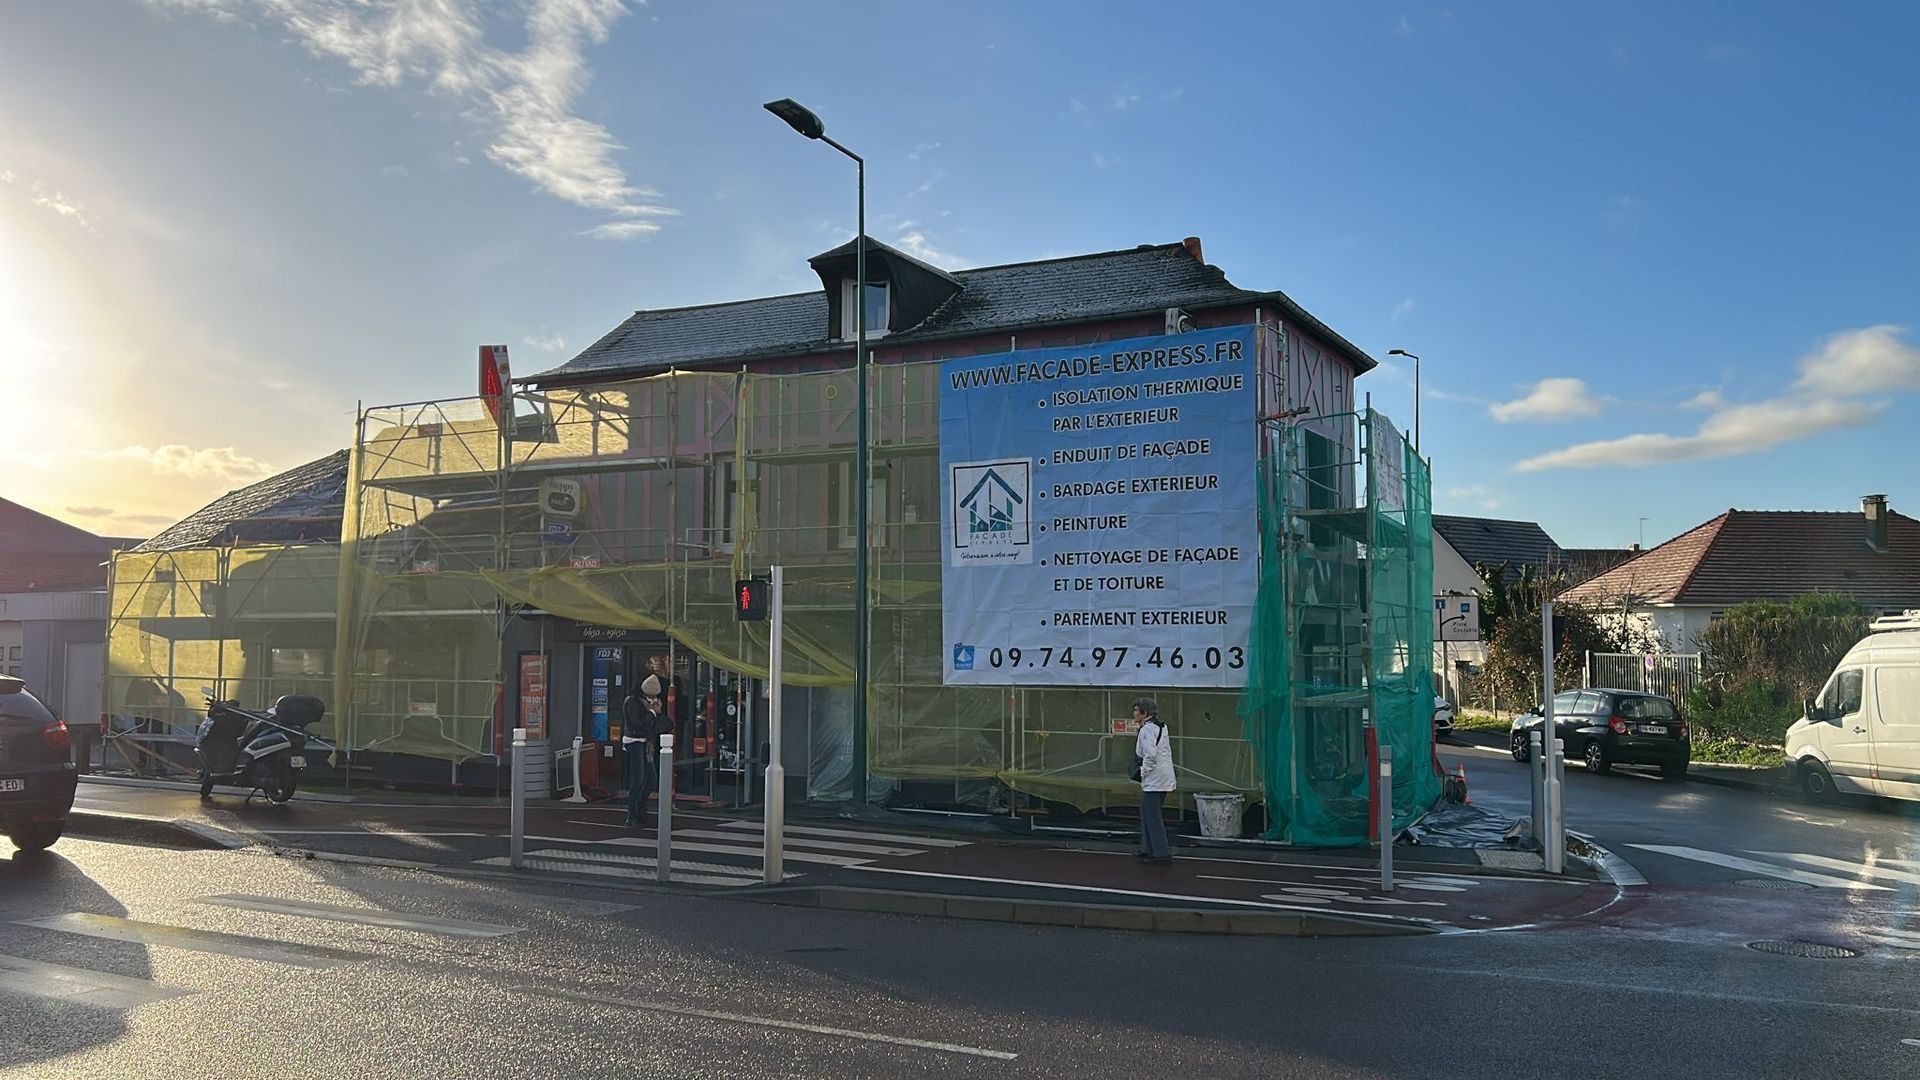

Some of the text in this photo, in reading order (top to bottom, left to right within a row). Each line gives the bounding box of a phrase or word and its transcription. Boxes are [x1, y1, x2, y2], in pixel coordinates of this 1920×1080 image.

[950, 340, 1243, 390] WWW.FACADE-EXPRESS.FR
[1052, 375, 1243, 407] ISOLATION THERMIQUE
[1052, 407, 1180, 432] PAR L'EXTERIEUR
[1052, 439, 1210, 465] ENDUIT DE FAÇADE
[1053, 475, 1219, 498] BARDAGE EXTERIEUR
[1053, 515, 1128, 532] PEINTURE
[1053, 547, 1239, 567] NETTOYAGE DE FAÇADE
[1054, 576, 1165, 592] ET DE TOITURE
[1053, 610, 1228, 627] PAREMENT EXTERIEUR
[597, 650, 611, 658] FDJ
[989, 646, 1245, 669] 09.74.97.46.03
